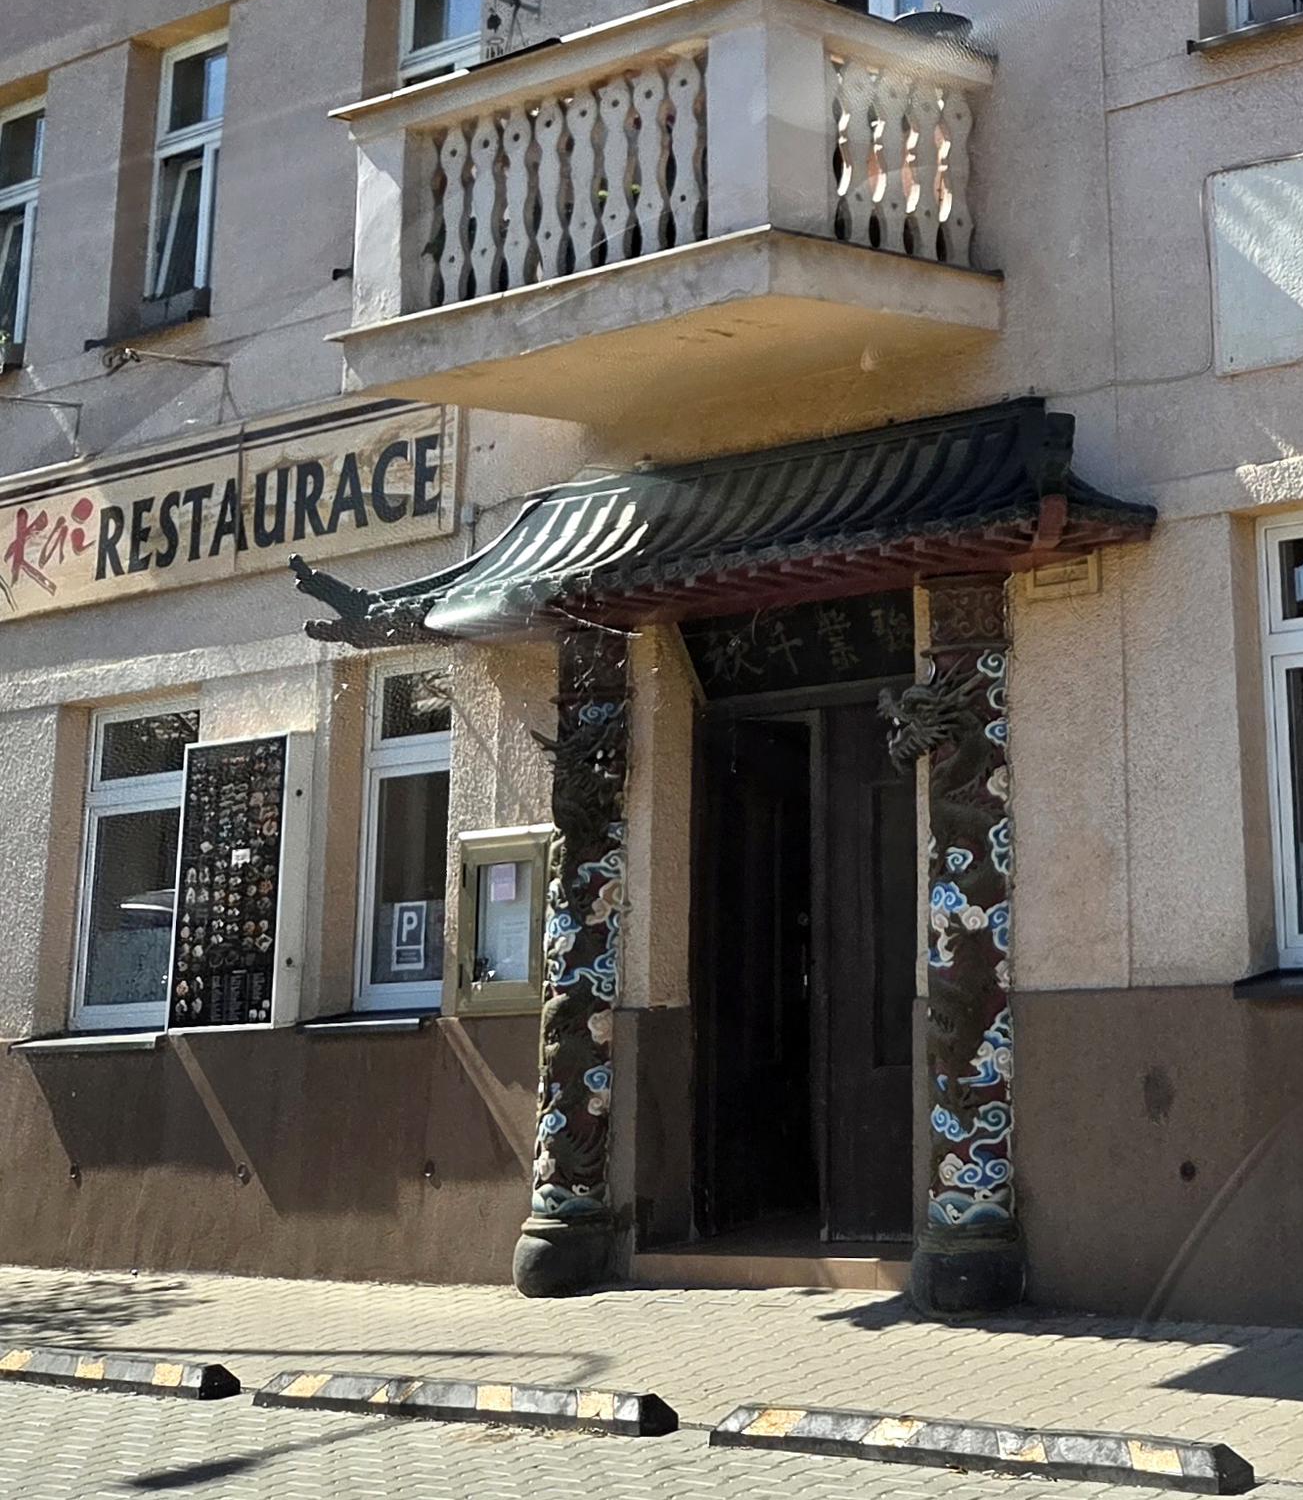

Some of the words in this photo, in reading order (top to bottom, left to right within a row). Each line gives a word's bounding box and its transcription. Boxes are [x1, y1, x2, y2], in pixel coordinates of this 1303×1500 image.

[4, 497, 94, 596] Kai
[95, 434, 442, 582] RESTAURACE
[402, 911, 418, 943] P
